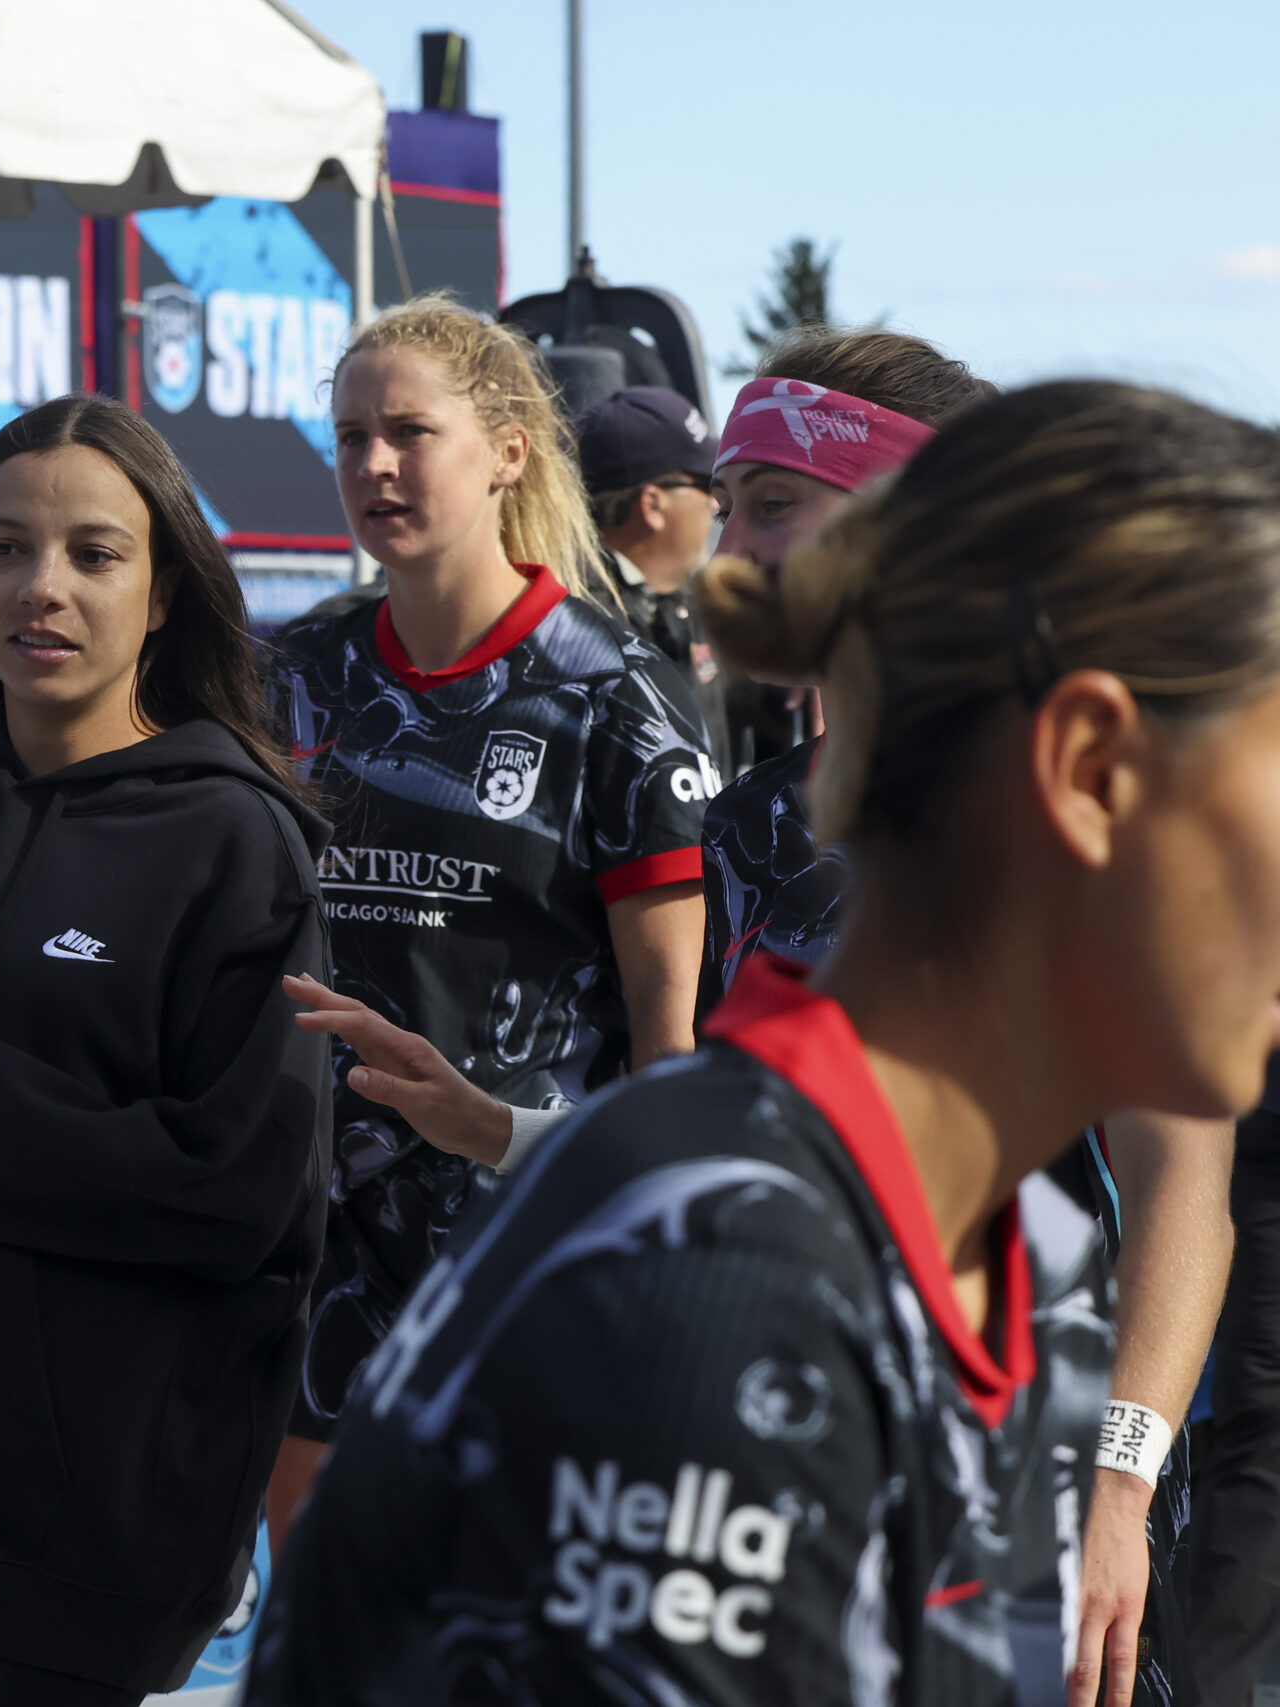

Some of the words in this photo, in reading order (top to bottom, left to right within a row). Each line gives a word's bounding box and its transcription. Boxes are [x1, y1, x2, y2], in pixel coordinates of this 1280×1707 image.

[205, 288, 354, 421] STAR
[488, 745, 535, 774] STARS
[316, 846, 496, 893] INTRUST
[325, 903, 400, 922] ICAGO'S
[57, 928, 106, 958] NIKE
[1116, 1409, 1152, 1466] HAVE
[548, 1456, 793, 1583] Nella
[542, 1540, 772, 1659] Spec
